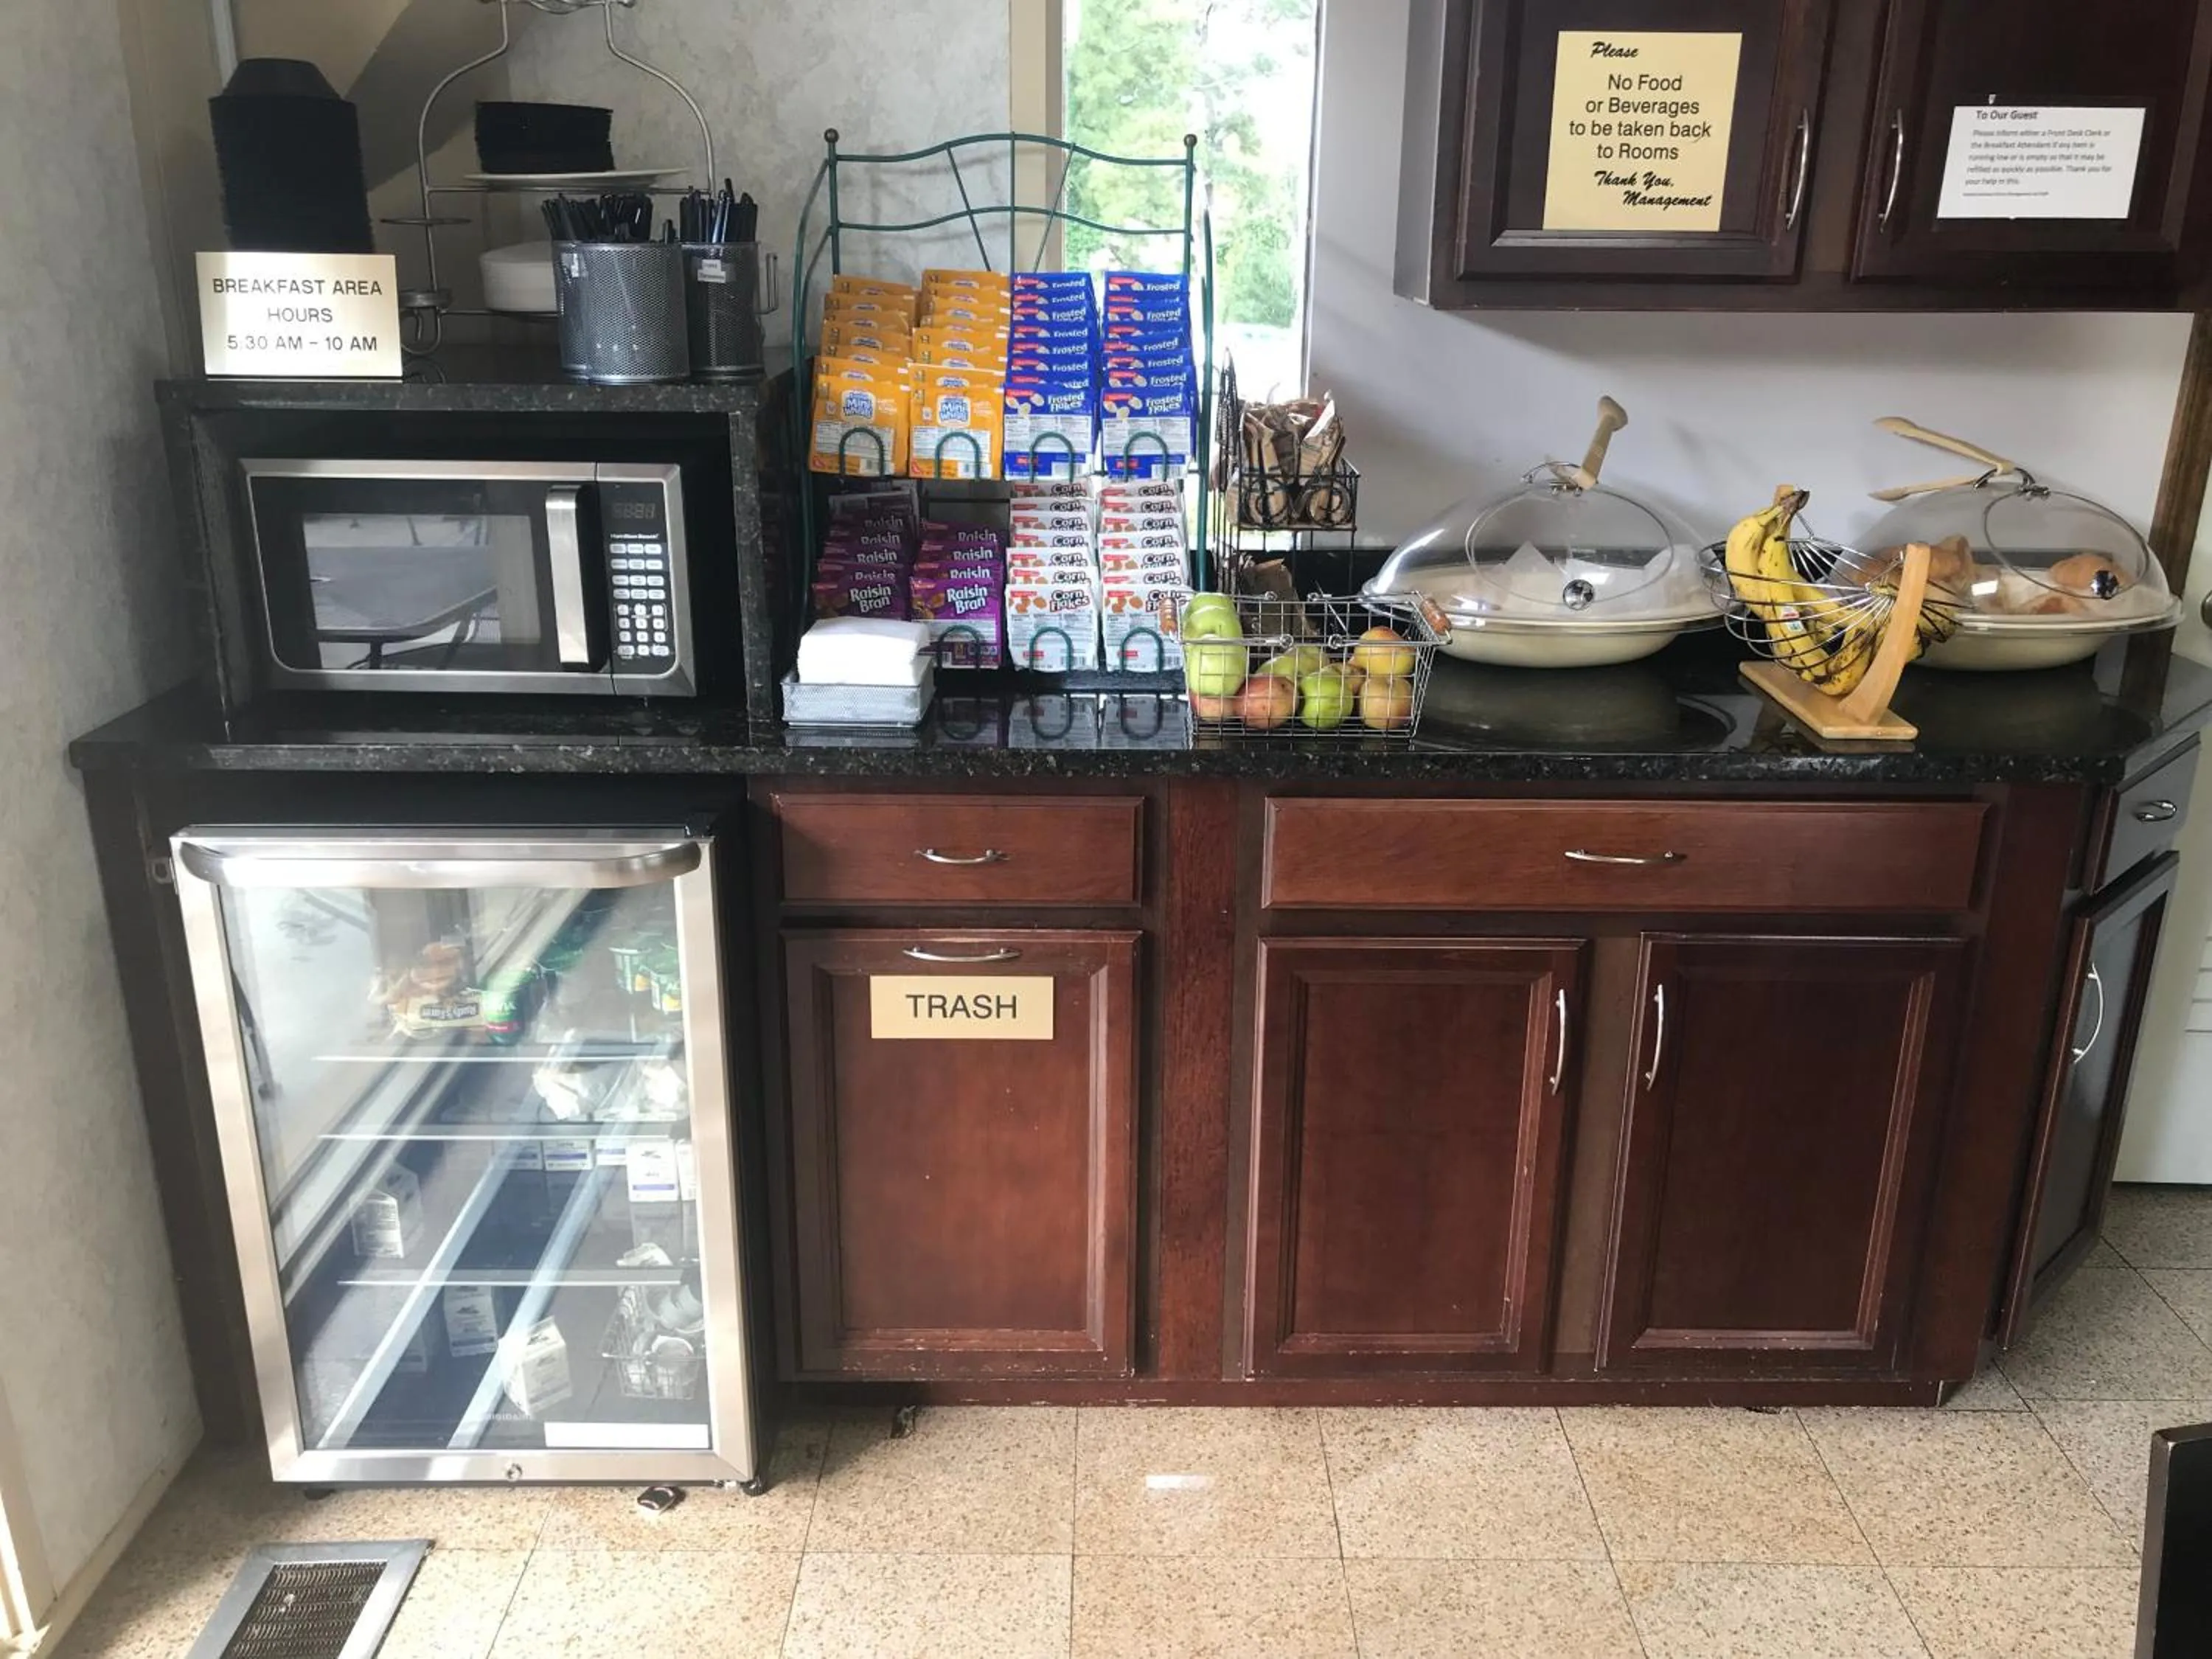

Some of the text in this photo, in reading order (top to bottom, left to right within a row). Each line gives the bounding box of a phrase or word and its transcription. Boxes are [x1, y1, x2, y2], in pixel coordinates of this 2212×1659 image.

[1590, 41, 1638, 58] Please
[1608, 74, 1683, 91] No Food
[1585, 97, 1700, 117] or Beverages
[1977, 110, 1988, 119] To
[1990, 110, 2008, 119] Our
[1569, 120, 1711, 137] to be taken back
[1597, 144, 1679, 160] to Rooms
[1594, 170, 1638, 187] Thank
[1622, 190, 1712, 210] Management
[213, 278, 383, 296] BREAKFAST AREA
[268, 307, 333, 323] HOURS
[276, 336, 302, 350] AM
[326, 337, 343, 350] 10
[350, 336, 378, 351] AM
[953, 546, 993, 560] Raisin
[849, 584, 891, 602] Raisin
[947, 584, 987, 602] Raisin
[1051, 590, 1084, 602] Corn
[859, 597, 890, 613] Bran
[956, 597, 986, 613] Bran
[905, 994, 1017, 1019] TRASH
